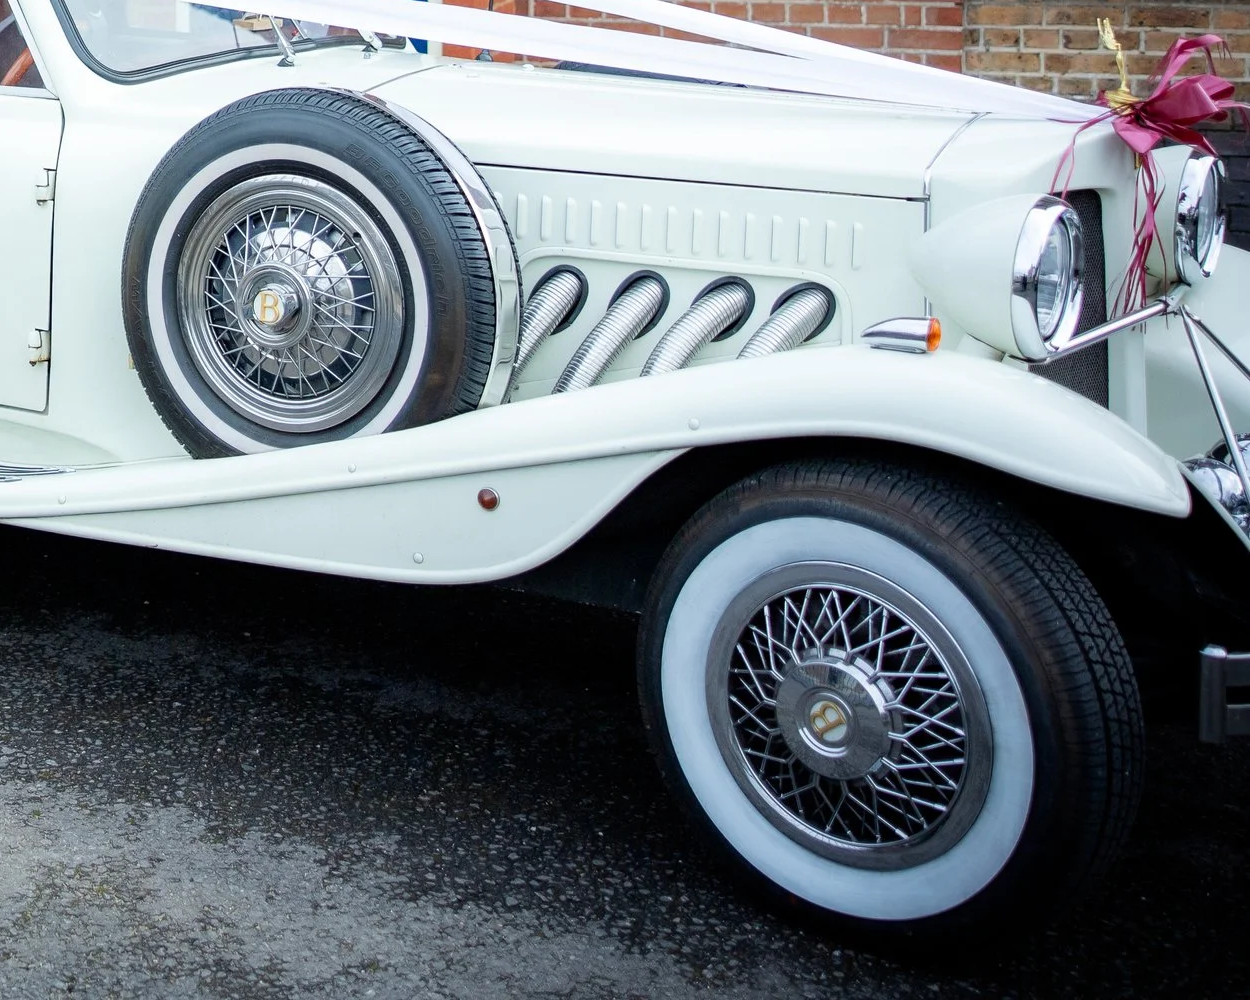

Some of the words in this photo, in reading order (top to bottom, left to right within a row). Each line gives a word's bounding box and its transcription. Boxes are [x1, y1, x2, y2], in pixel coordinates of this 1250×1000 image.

[344, 142, 450, 318] BFGoodrich
[260, 291, 280, 324] B
[810, 701, 846, 739] B
